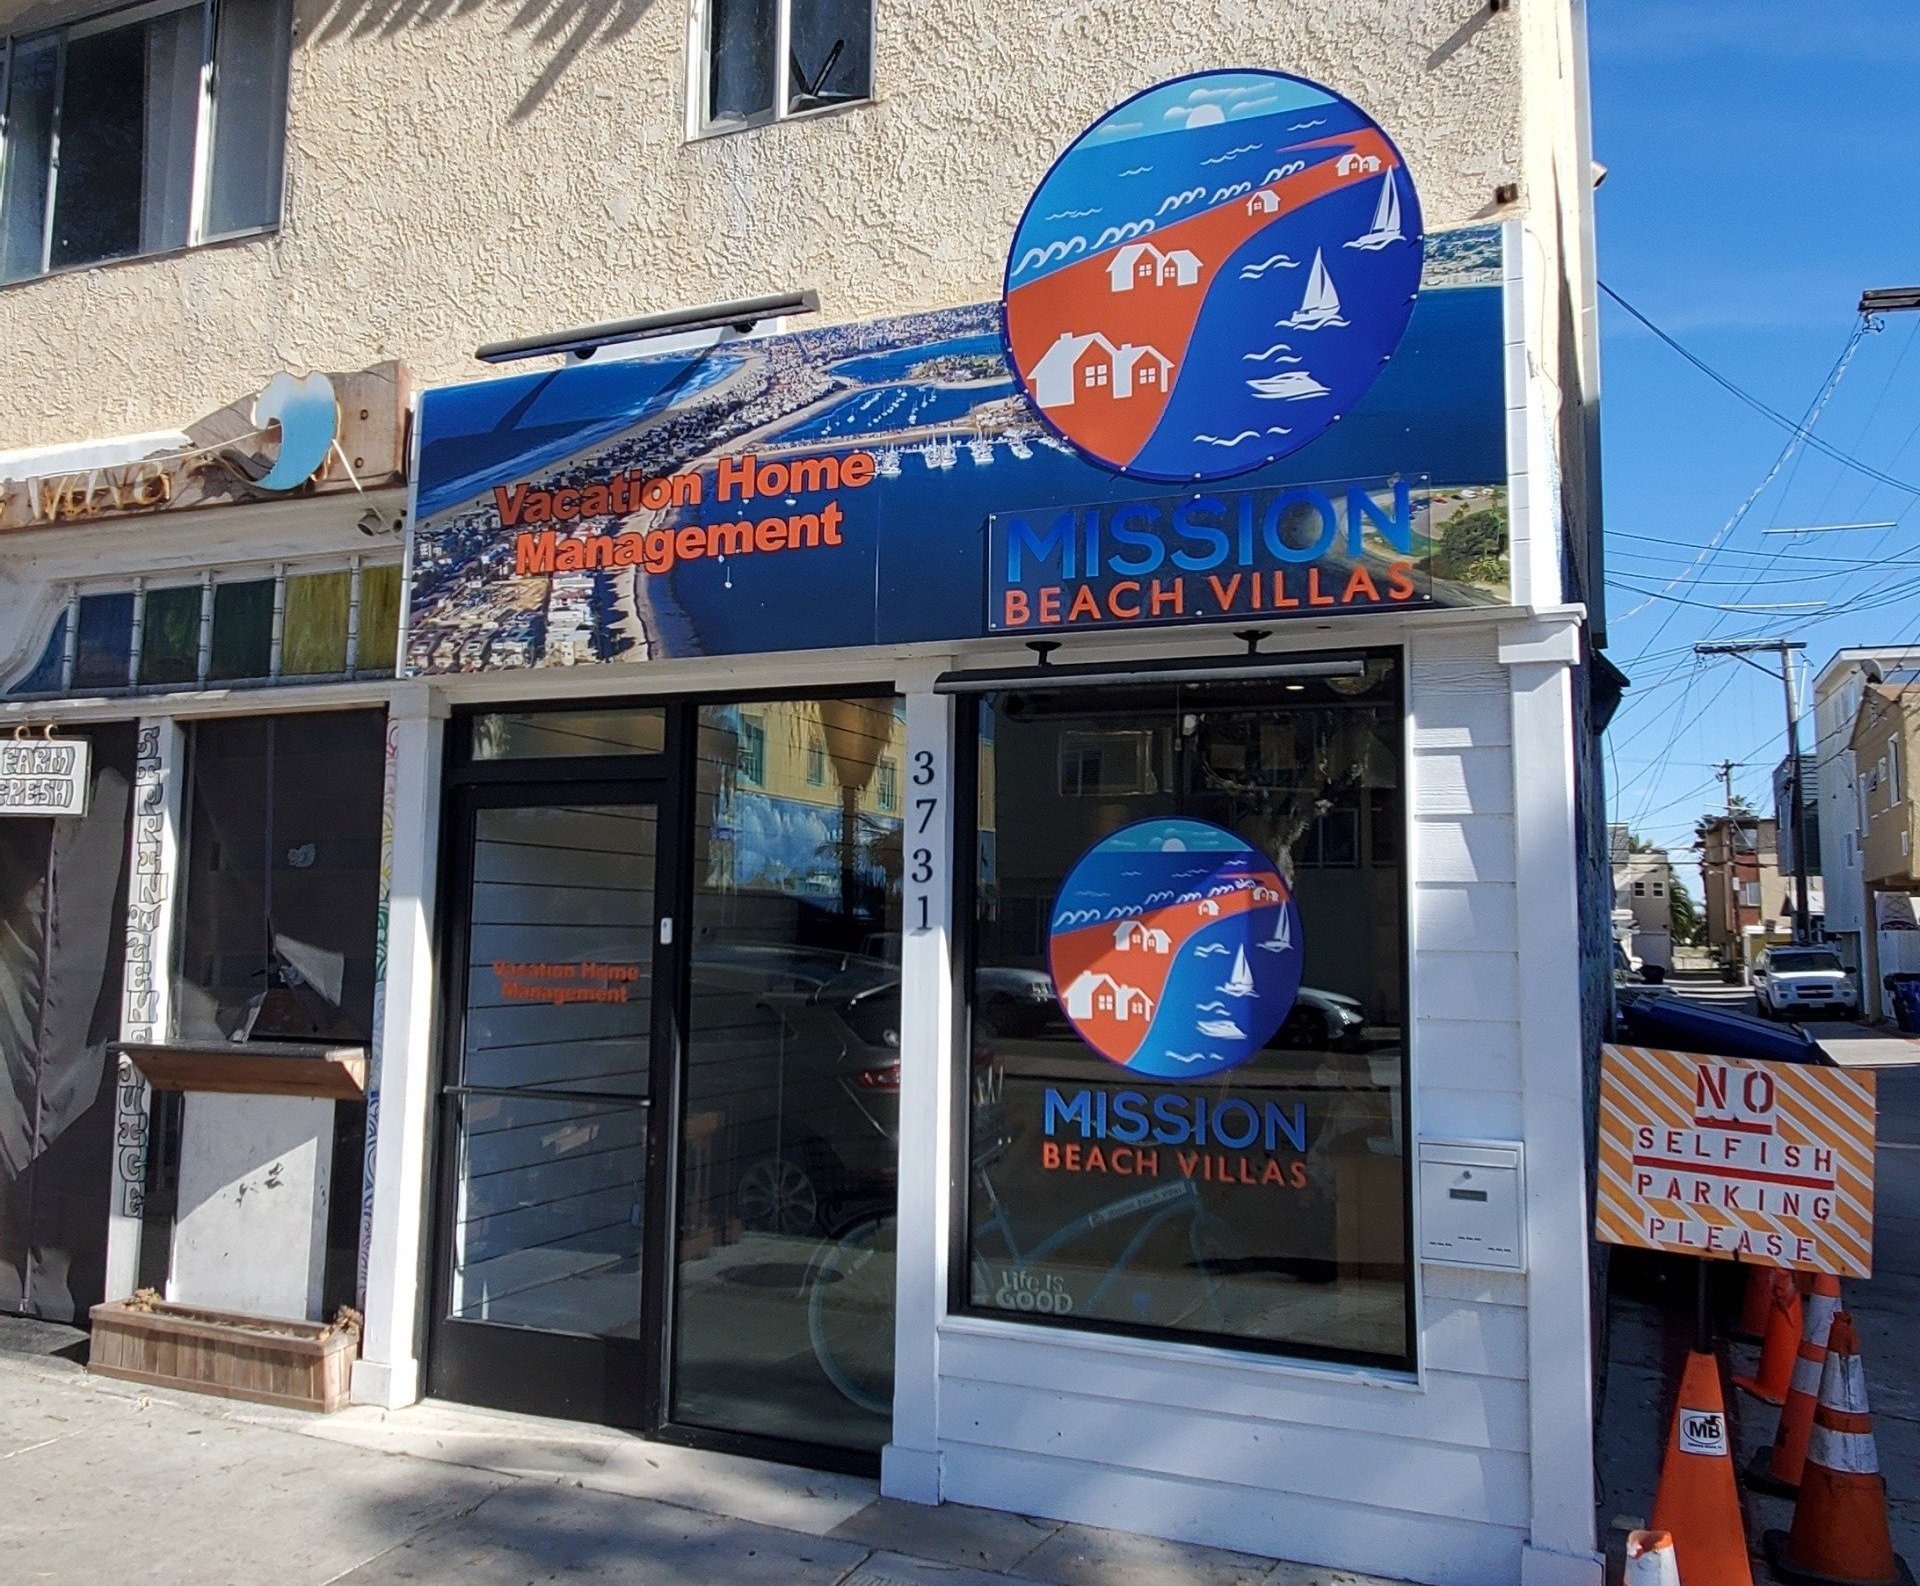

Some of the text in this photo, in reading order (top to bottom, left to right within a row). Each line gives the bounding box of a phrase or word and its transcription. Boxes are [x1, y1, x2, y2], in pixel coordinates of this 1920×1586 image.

[494, 452, 877, 527] Vacation Home
[514, 501, 844, 576] Management
[1007, 480, 1412, 583] MISSION
[1004, 561, 1415, 626] BEACH VILLAS
[912, 750, 938, 931] 3731
[493, 960, 639, 981] Vacation Home
[502, 981, 628, 1006] Management
[1696, 1065, 1775, 1113] NO
[1043, 1088, 1306, 1153] MISSION
[1042, 1141, 1308, 1190] BEACH VILLAS
[1638, 1127, 1832, 1173] SELFISH
[1638, 1173, 1831, 1220] PARKING
[1649, 1217, 1813, 1262] PLEASE
[996, 1286, 1073, 1314] GOOD
[1690, 1420, 1720, 1438] MB
